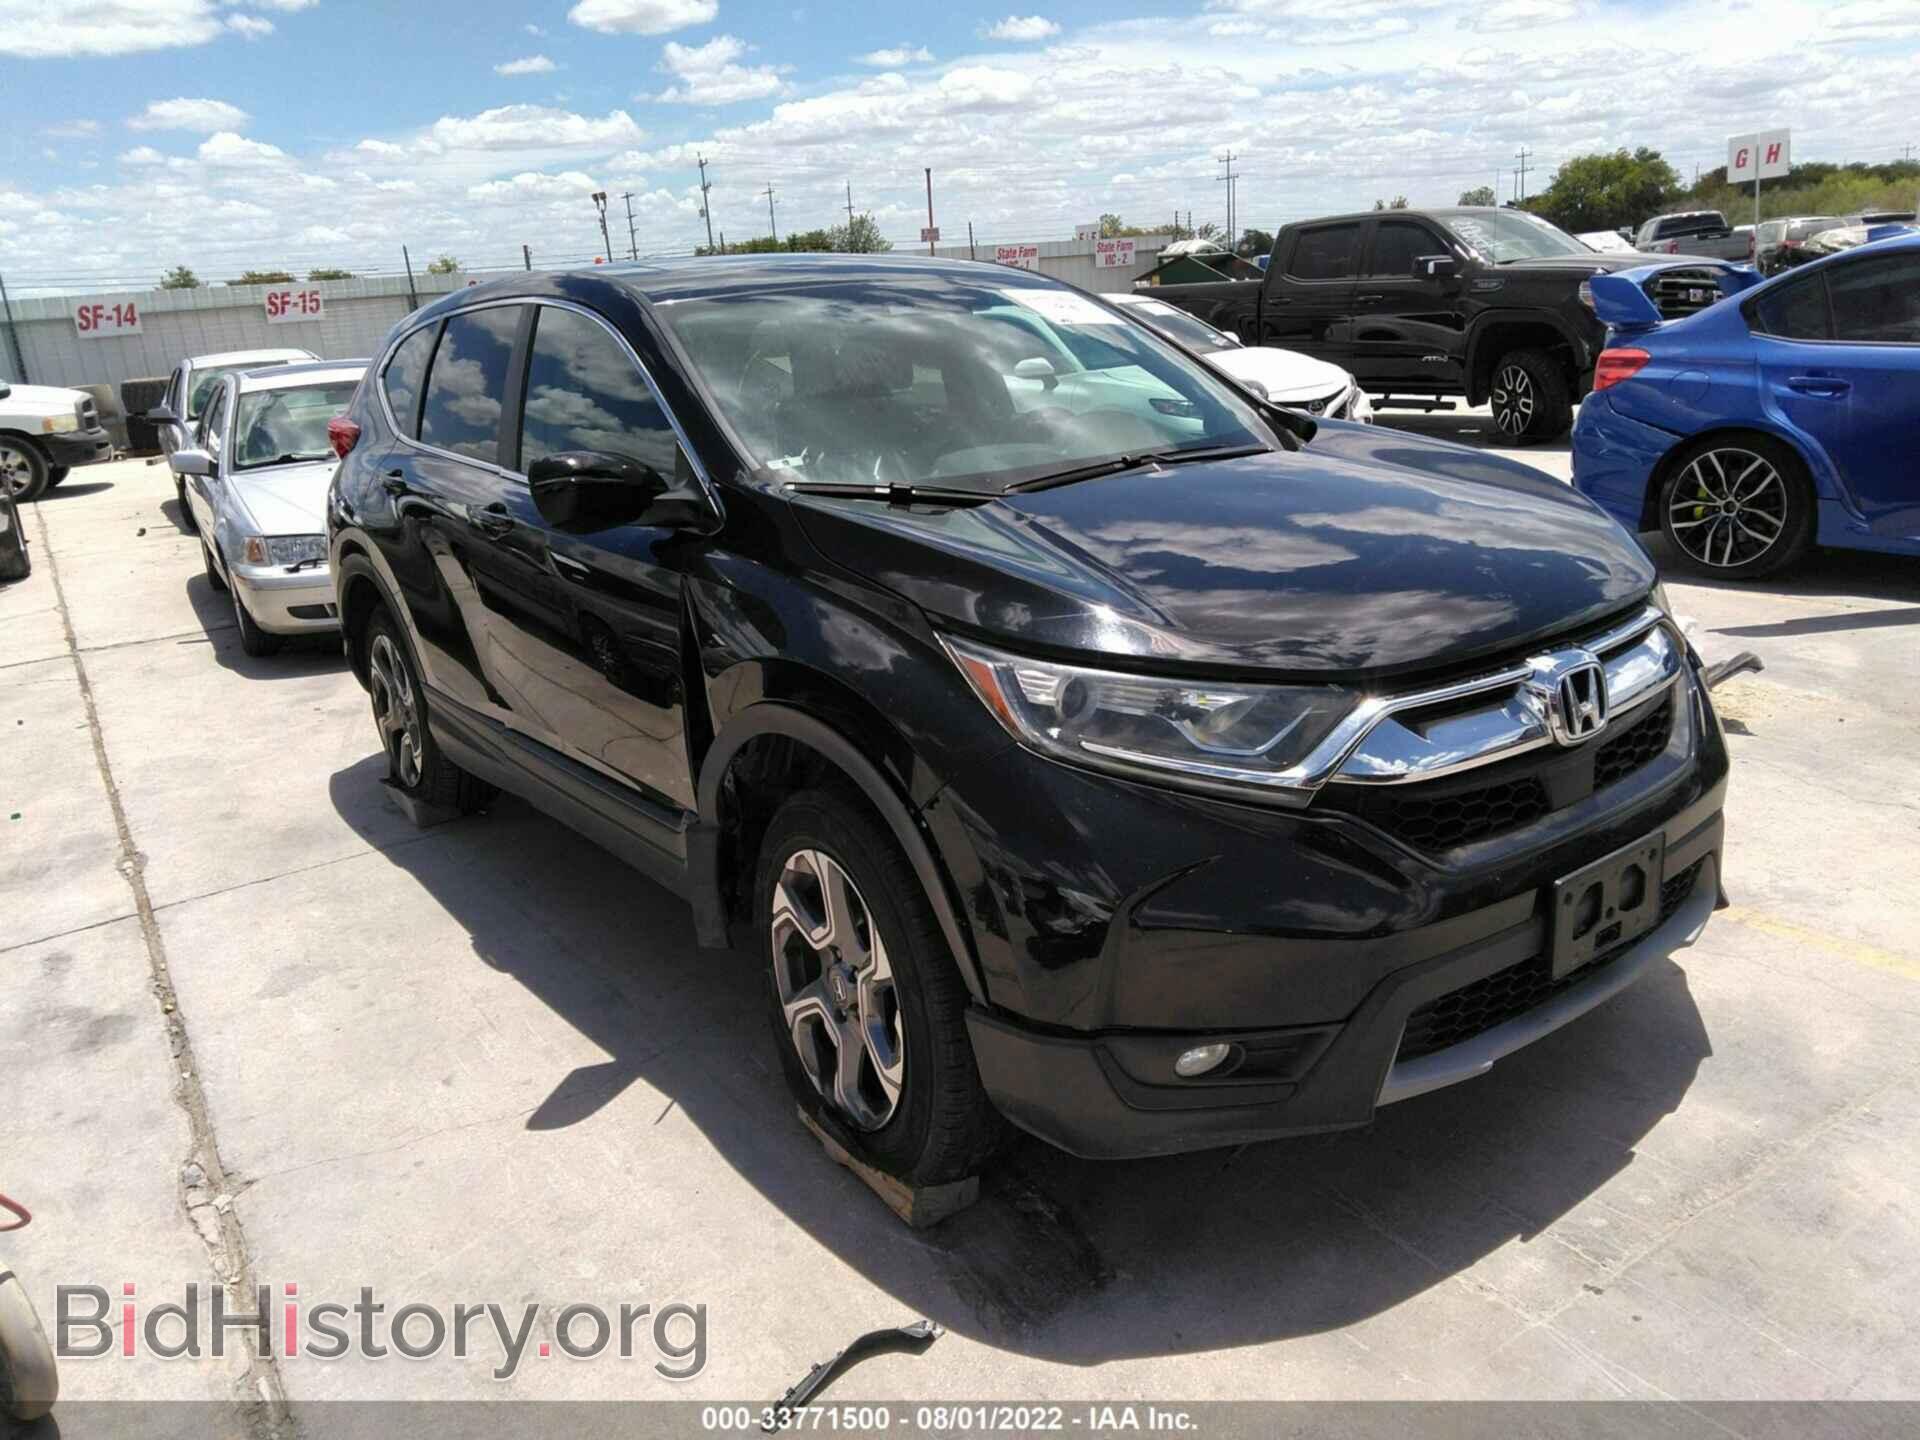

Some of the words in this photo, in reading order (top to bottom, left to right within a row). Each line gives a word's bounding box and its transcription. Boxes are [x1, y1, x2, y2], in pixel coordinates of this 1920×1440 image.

[1735, 148, 1749, 169] G
[1765, 142, 1782, 165] H
[997, 247, 1017, 259] State
[1018, 246, 1037, 257] Farm
[1097, 241, 1116, 253] State
[1116, 240, 1134, 251] Farm
[1121, 253, 1129, 264] 2
[267, 290, 321, 316] SF-15
[77, 302, 137, 331] SF-14
